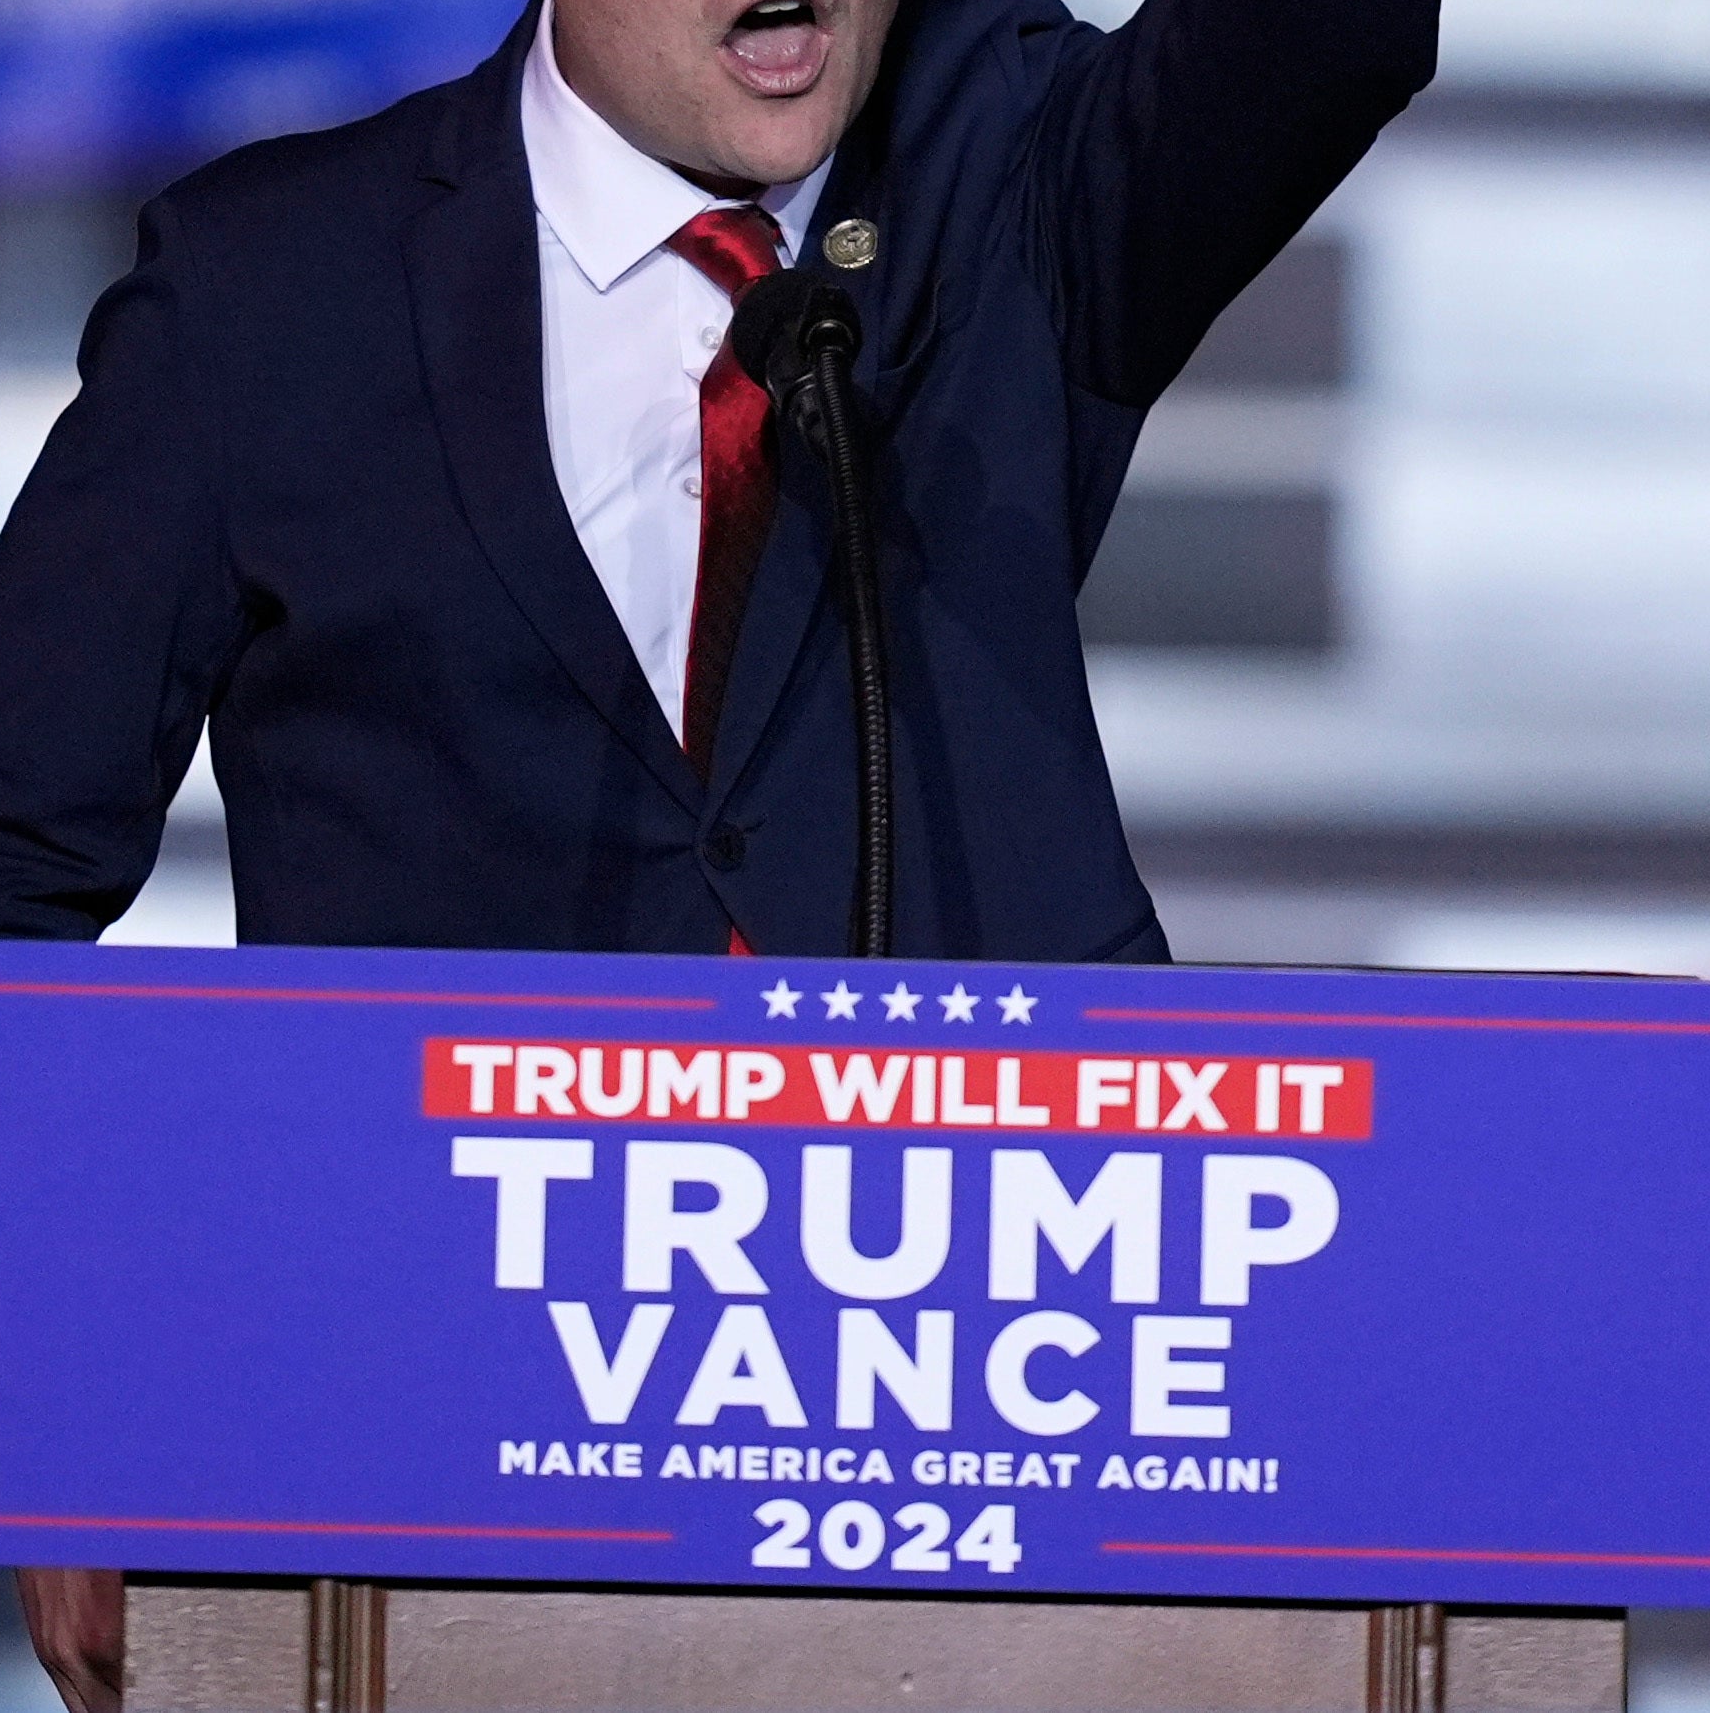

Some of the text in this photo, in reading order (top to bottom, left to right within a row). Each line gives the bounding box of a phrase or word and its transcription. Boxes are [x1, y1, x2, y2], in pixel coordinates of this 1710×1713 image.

[452, 1043, 1345, 1134] TRUMP WILL FIX IT
[450, 1135, 1341, 1308] TRUMP
[546, 1300, 1233, 1439] VANCE
[498, 1440, 1280, 1494] MAKE AMERICA GREAT AGAIN!
[750, 1498, 1023, 1574] 2024
